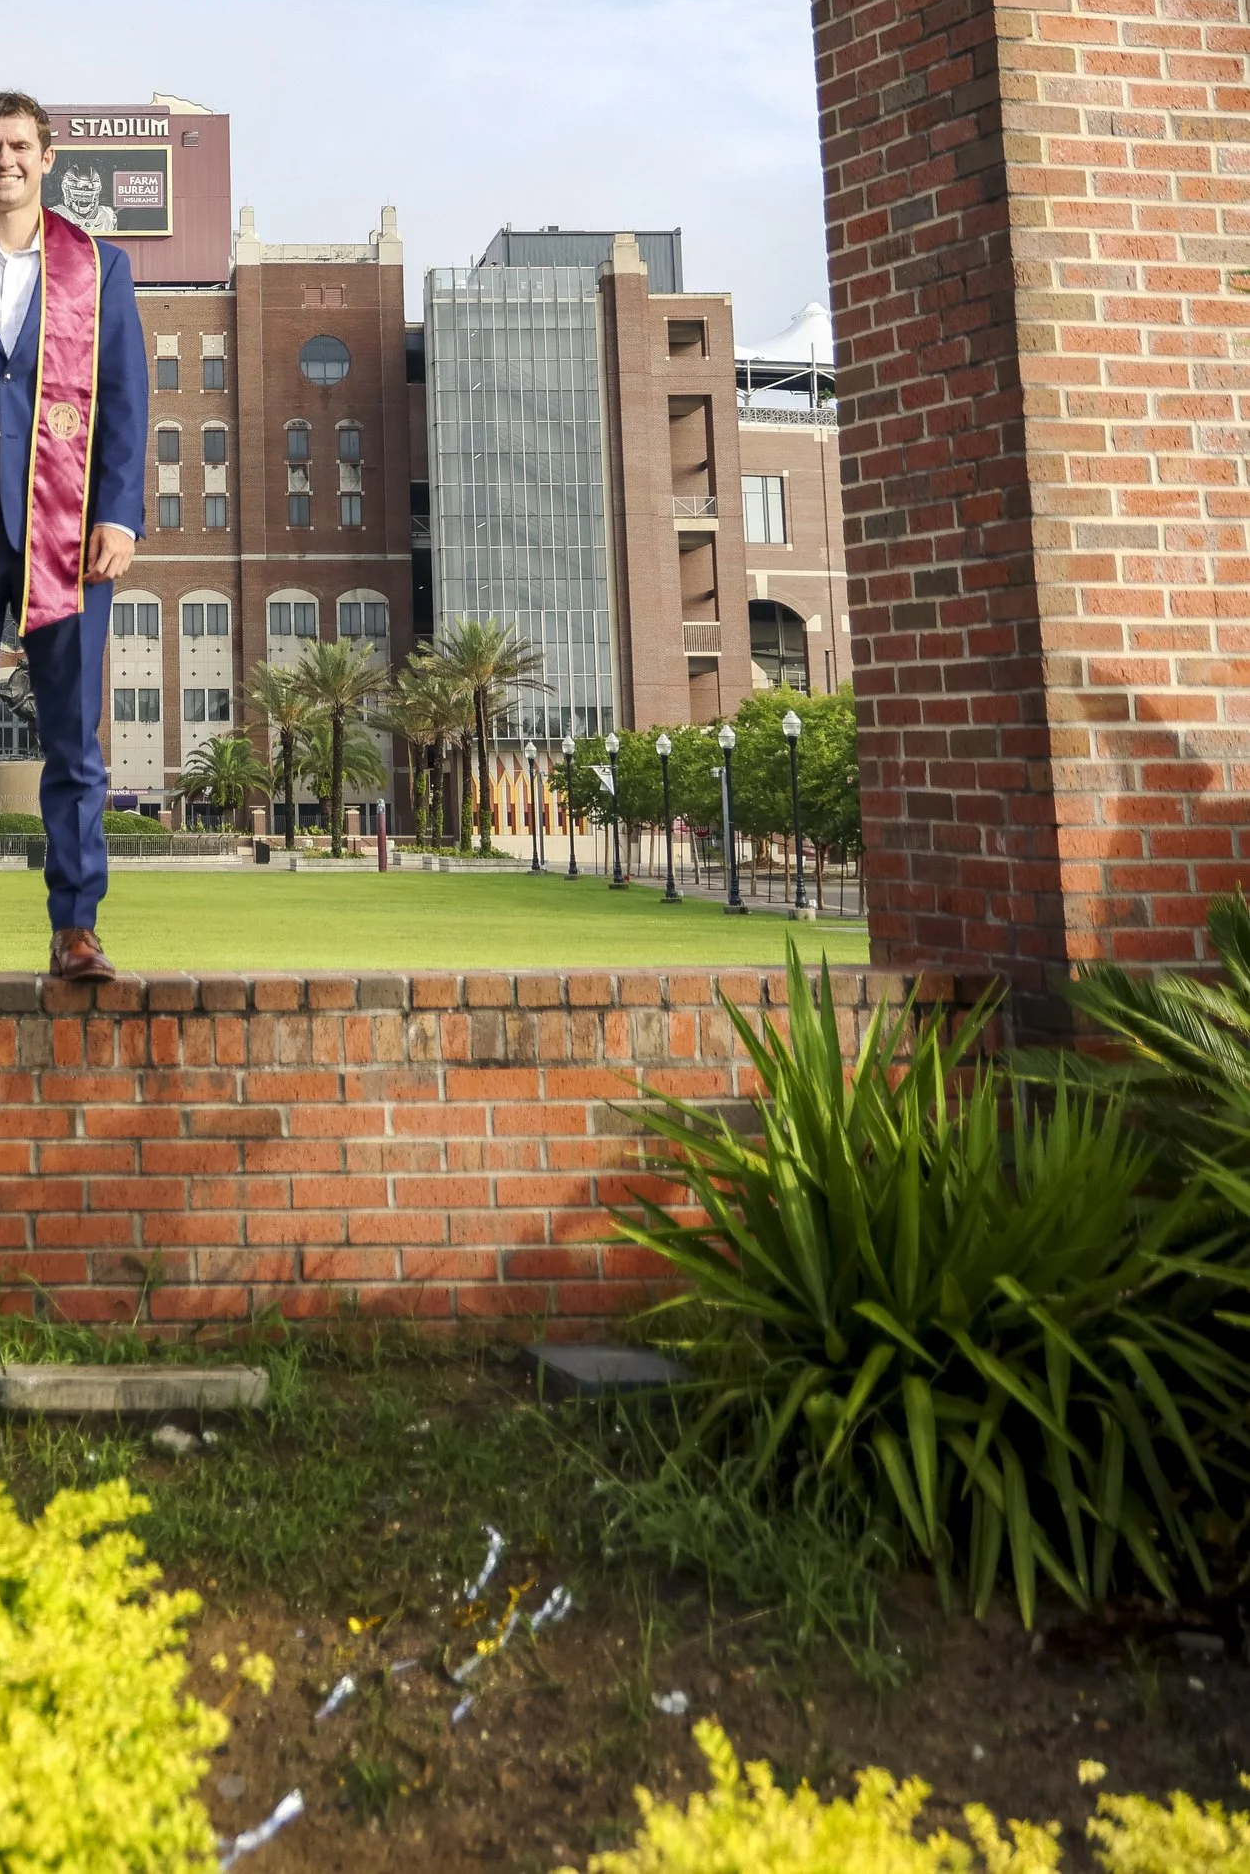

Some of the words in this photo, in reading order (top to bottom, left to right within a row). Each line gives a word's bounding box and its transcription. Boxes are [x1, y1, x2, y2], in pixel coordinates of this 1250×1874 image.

[70, 118, 170, 137] STADIUM
[129, 176, 158, 185] FARM
[118, 186, 159, 195] BUREAU
